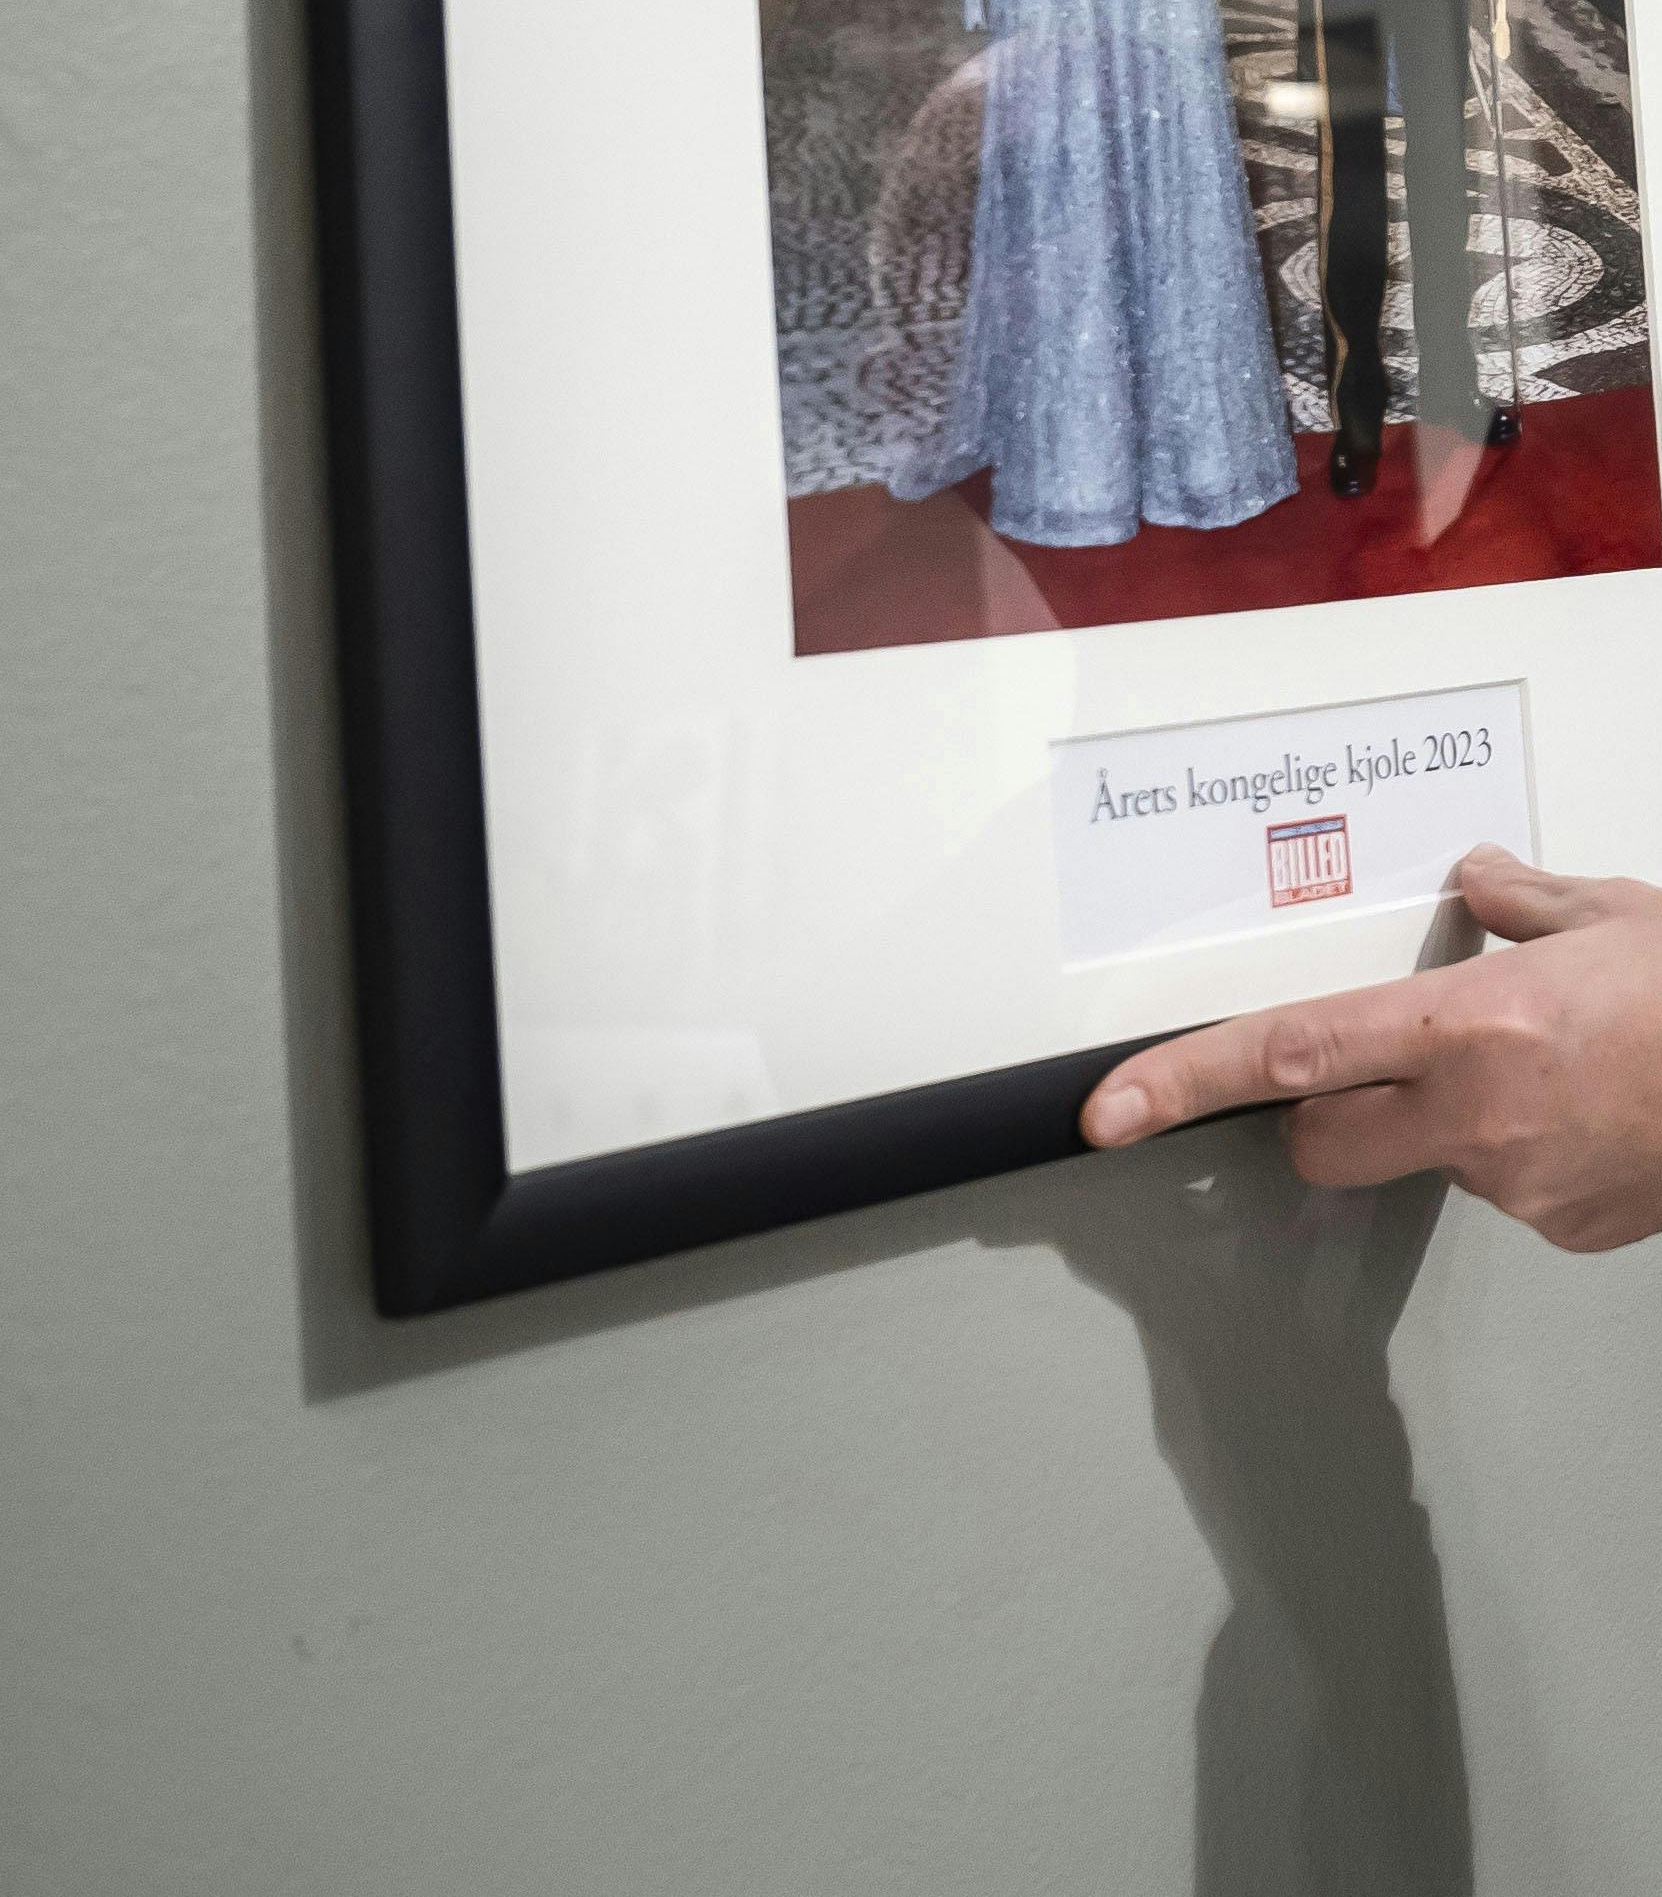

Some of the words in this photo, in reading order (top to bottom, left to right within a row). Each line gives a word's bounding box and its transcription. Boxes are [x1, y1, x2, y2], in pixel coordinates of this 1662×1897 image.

[1090, 764, 1179, 824] Årets
[1186, 752, 1340, 814] kongelige
[1344, 737, 1417, 798] kjole
[1423, 726, 1494, 774] 2023
